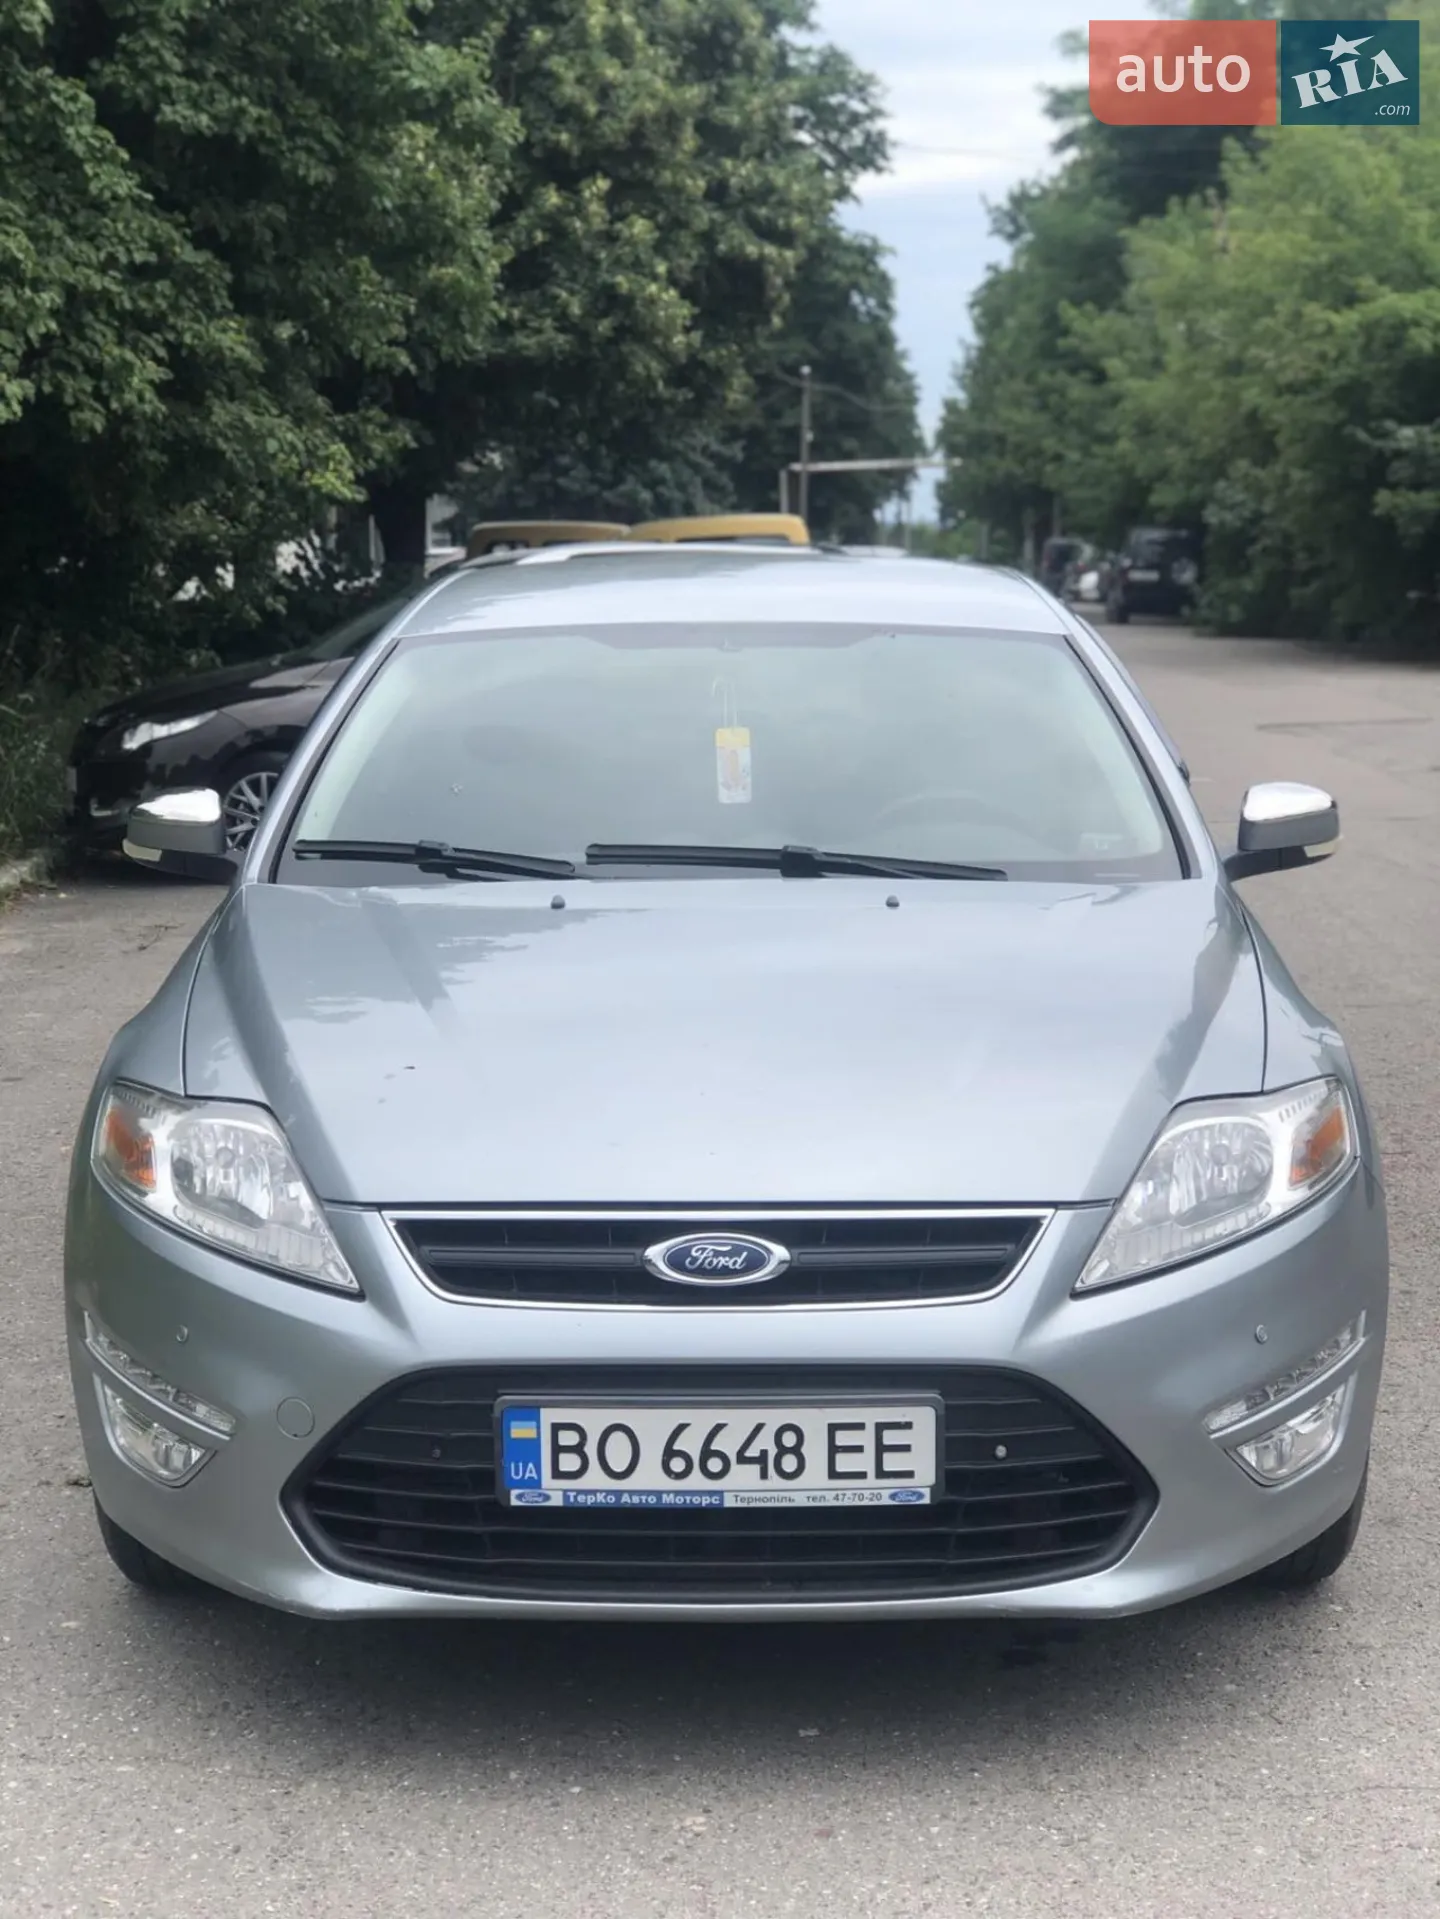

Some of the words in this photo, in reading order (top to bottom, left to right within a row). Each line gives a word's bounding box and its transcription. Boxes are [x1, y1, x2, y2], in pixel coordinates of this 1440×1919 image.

[685, 1244, 748, 1270] Ford
[550, 1421, 641, 1481] BO
[661, 1421, 807, 1481] 6648
[826, 1420, 916, 1480] EE
[510, 1461, 539, 1481] UA
[566, 1491, 616, 1506] ТерКо
[620, 1492, 657, 1504] Авто
[661, 1493, 721, 1507] Моторс
[733, 1493, 796, 1506] Тернопіль
[833, 1492, 883, 1503] 47-70-20
